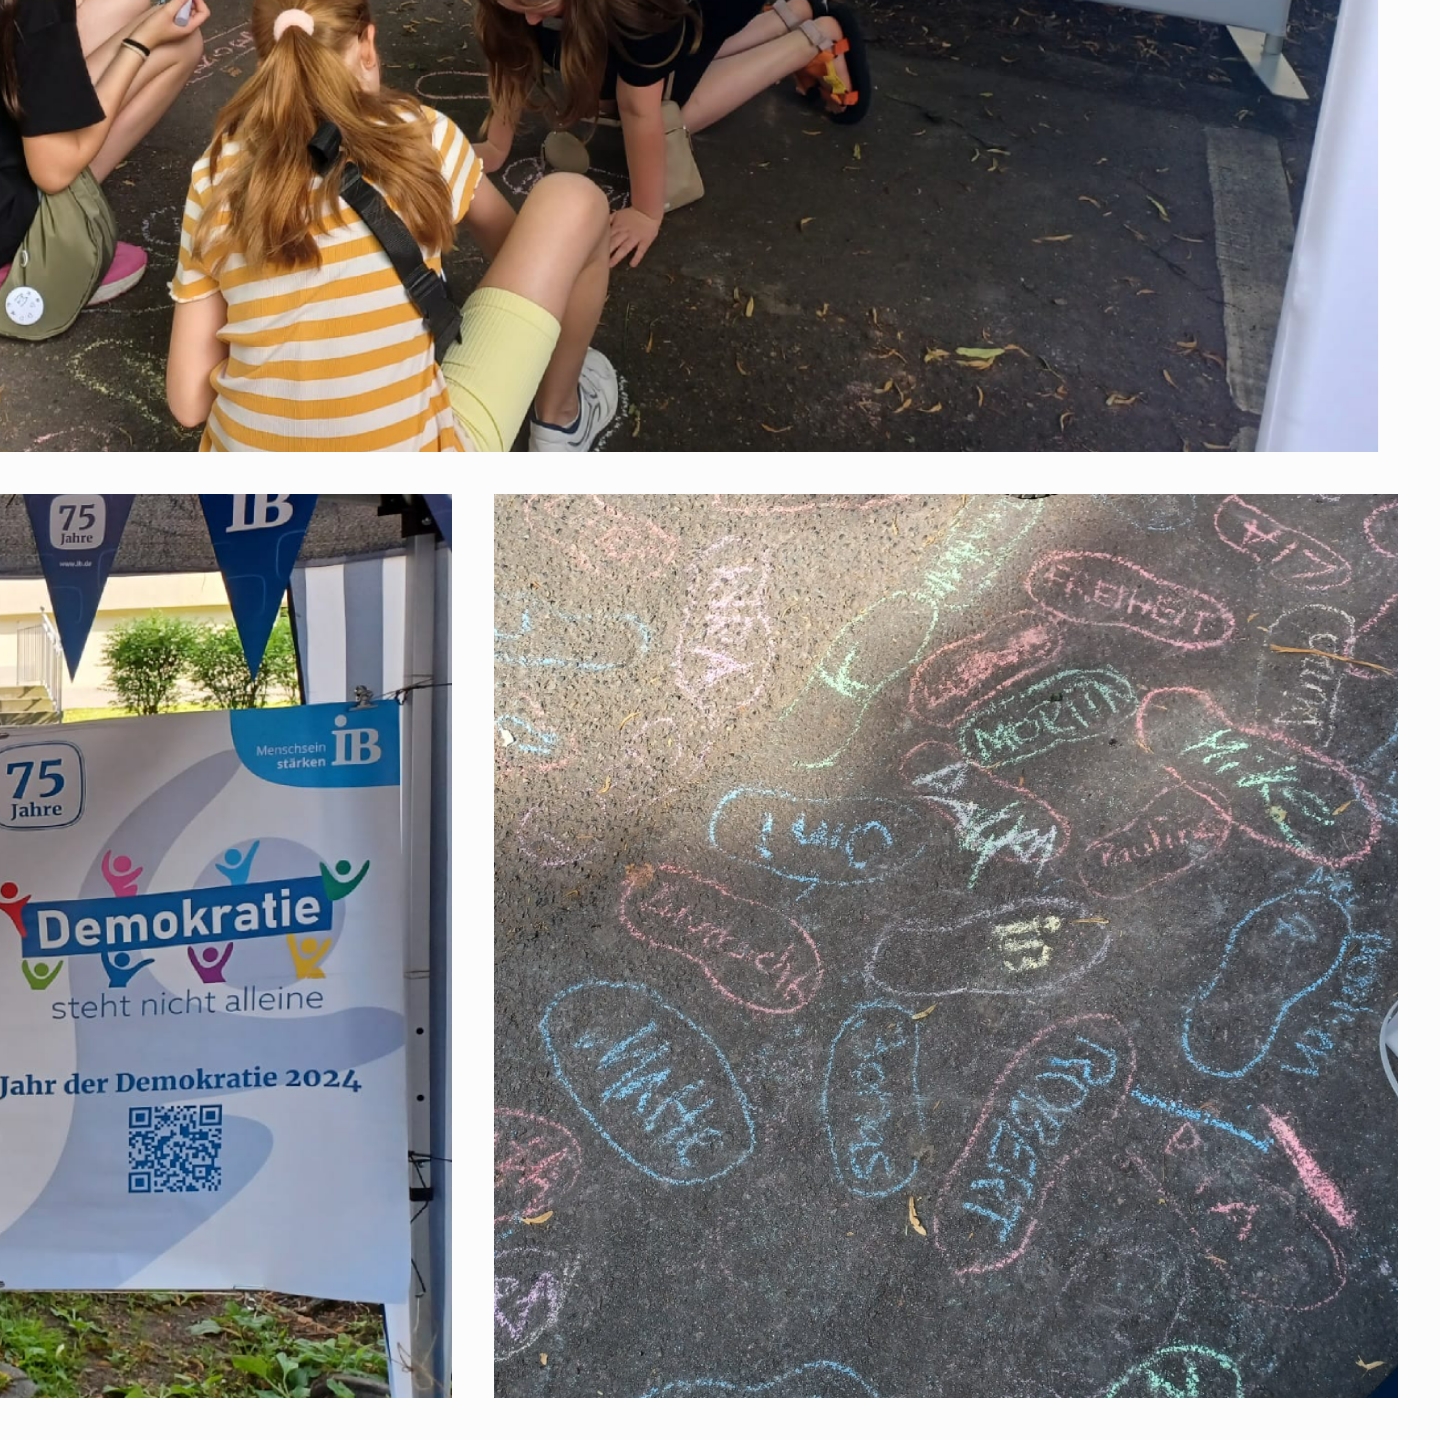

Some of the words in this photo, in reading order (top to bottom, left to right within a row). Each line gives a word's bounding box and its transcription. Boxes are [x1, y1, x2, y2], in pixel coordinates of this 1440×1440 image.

[58, 503, 96, 532] 75
[60, 530, 94, 547] Jahre
[256, 741, 327, 758] Menschsein
[276, 755, 327, 771] stärken
[6, 758, 66, 800] 75
[10, 800, 63, 822] Jahre
[36, 886, 323, 950] Demokratie
[51, 988, 132, 1021] steht
[140, 988, 217, 1017] nicht
[224, 985, 325, 1014] alleine
[63, 1071, 109, 1096] der
[115, 1065, 279, 1094] Demokratie
[285, 1068, 363, 1094] 2024
